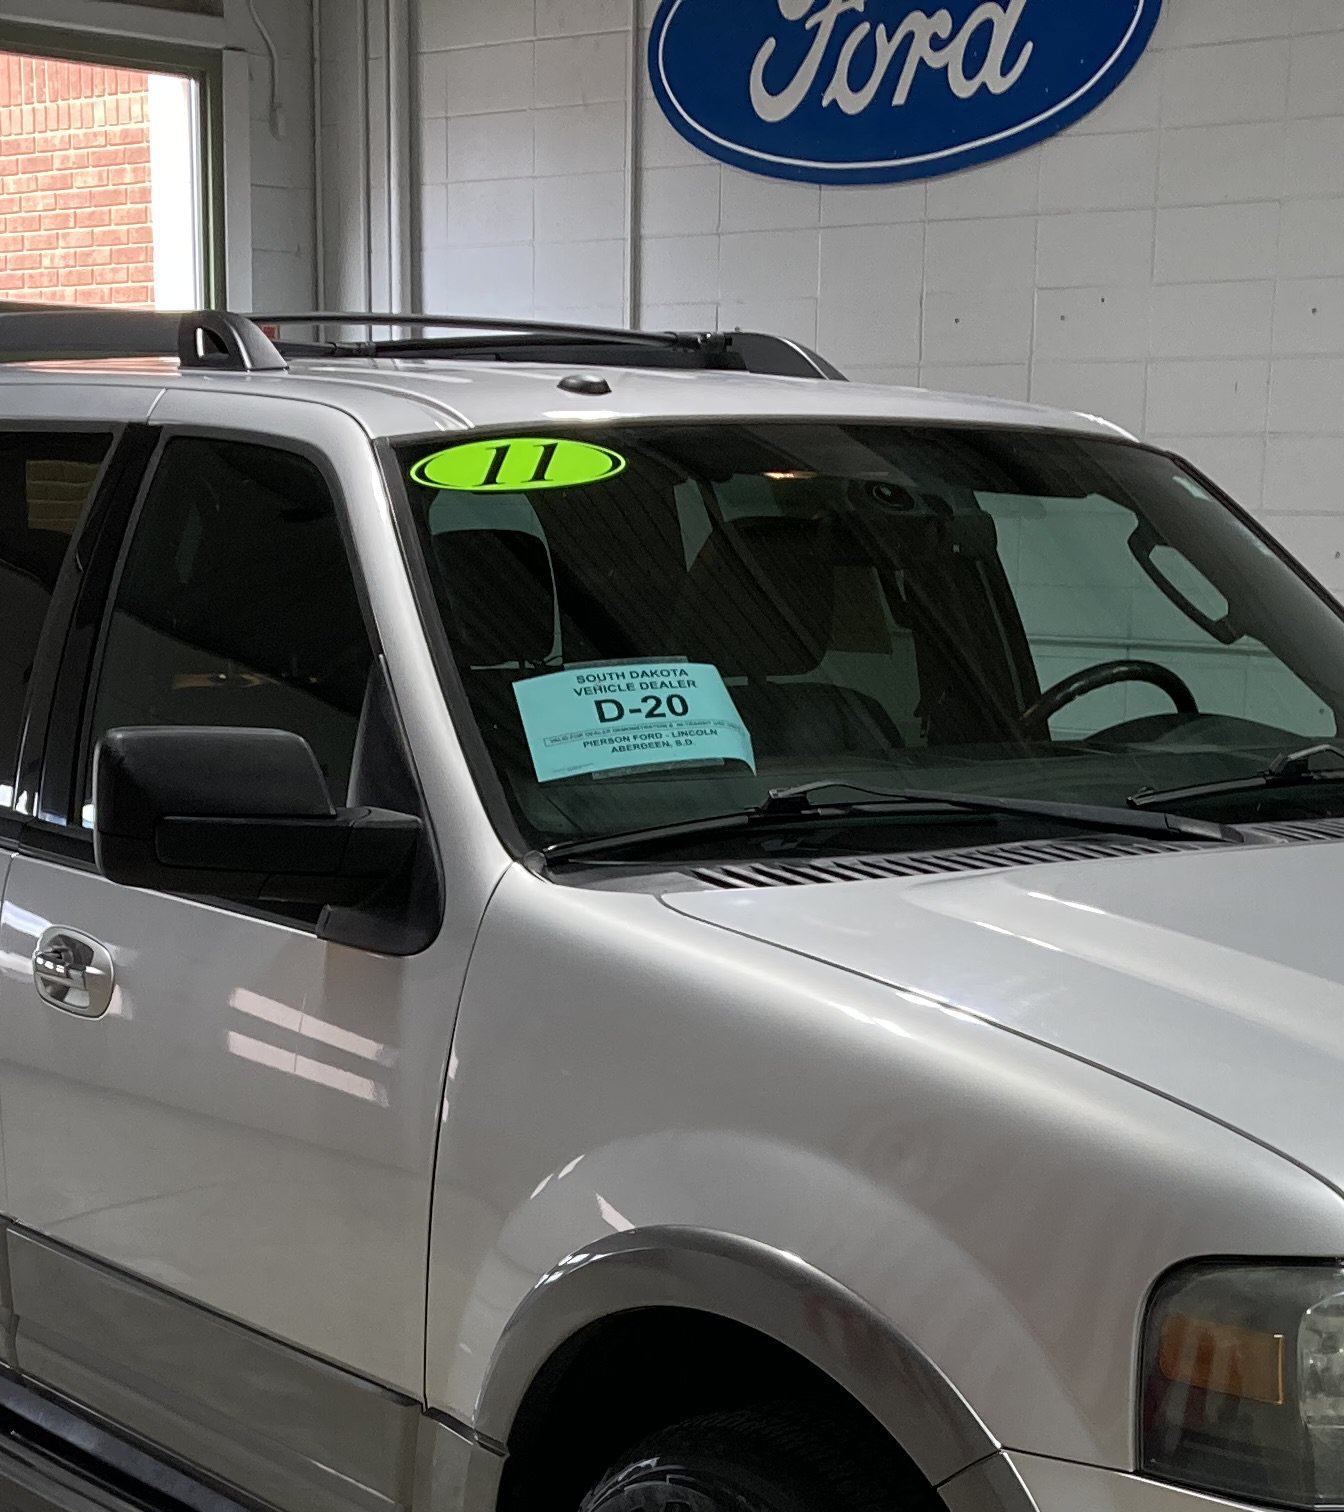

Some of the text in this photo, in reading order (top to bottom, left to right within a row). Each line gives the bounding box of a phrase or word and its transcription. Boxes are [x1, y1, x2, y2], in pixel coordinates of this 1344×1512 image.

[750, 0, 1033, 123] Ford
[478, 442, 559, 486] 11
[573, 679, 697, 697] VEHICLE DEALER
[576, 668, 689, 685] SOUTH DAKOTA
[594, 694, 689, 723] D-20
[583, 735, 631, 748] PIERSON
[633, 732, 663, 742] FORD
[671, 728, 718, 738] LINCOLN
